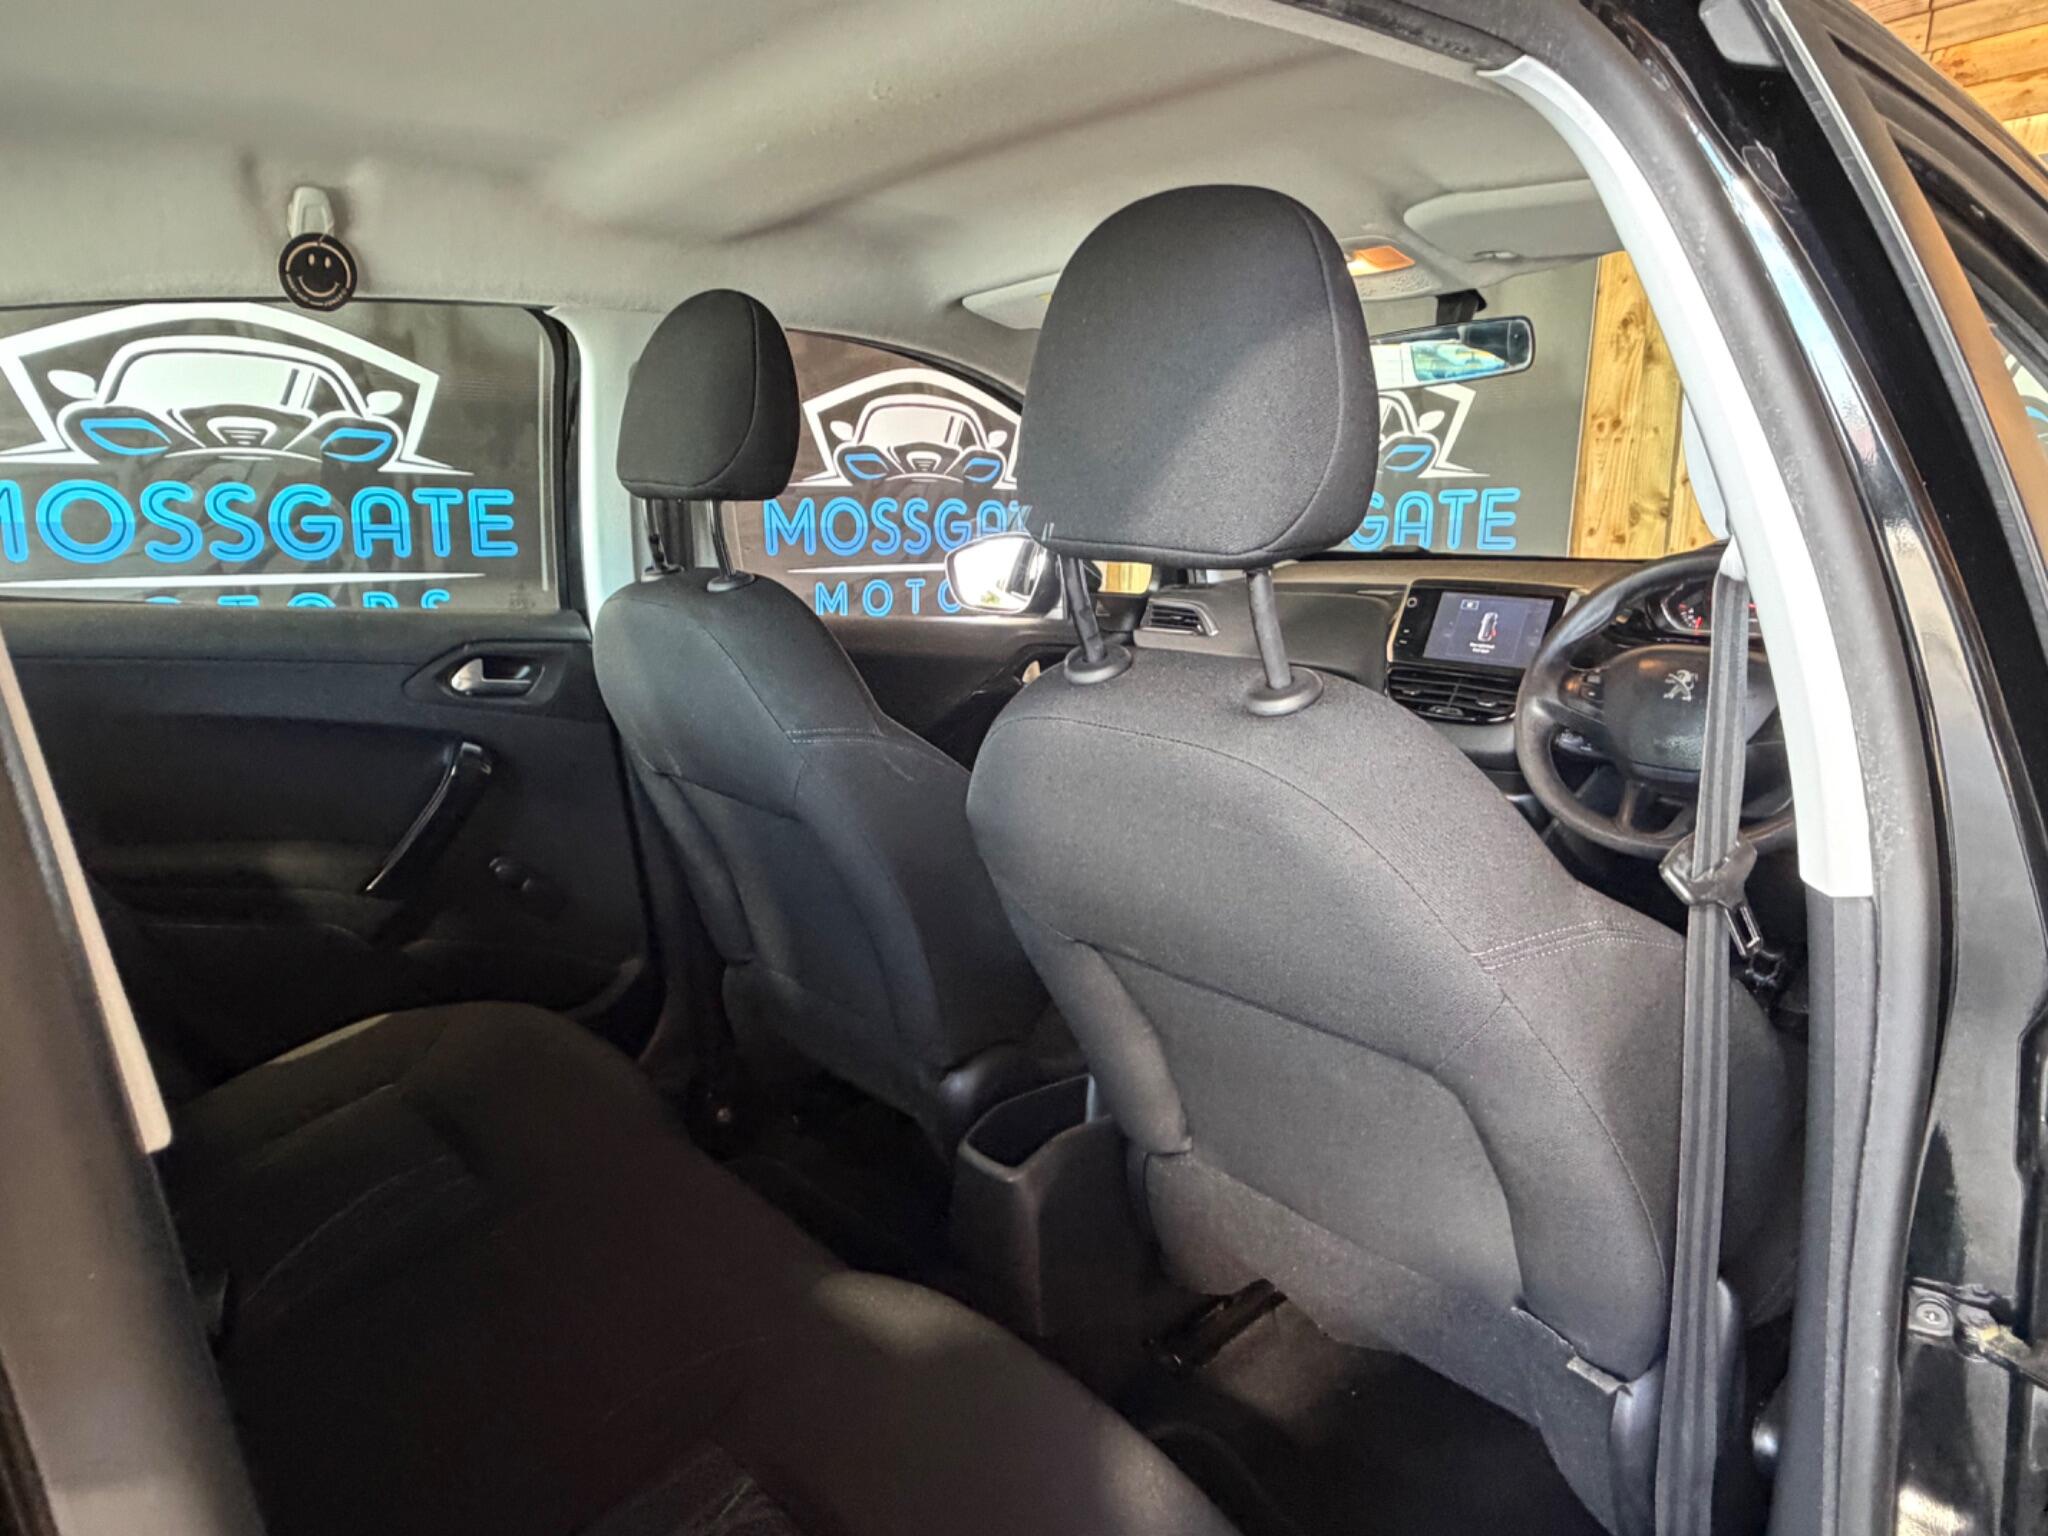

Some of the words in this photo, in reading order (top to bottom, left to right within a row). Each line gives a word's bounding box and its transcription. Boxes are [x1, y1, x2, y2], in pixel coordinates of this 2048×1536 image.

[763, 497, 1026, 556] MOSSGA
[1350, 487, 1521, 551] GATE
[815, 579, 963, 617] MOTO
